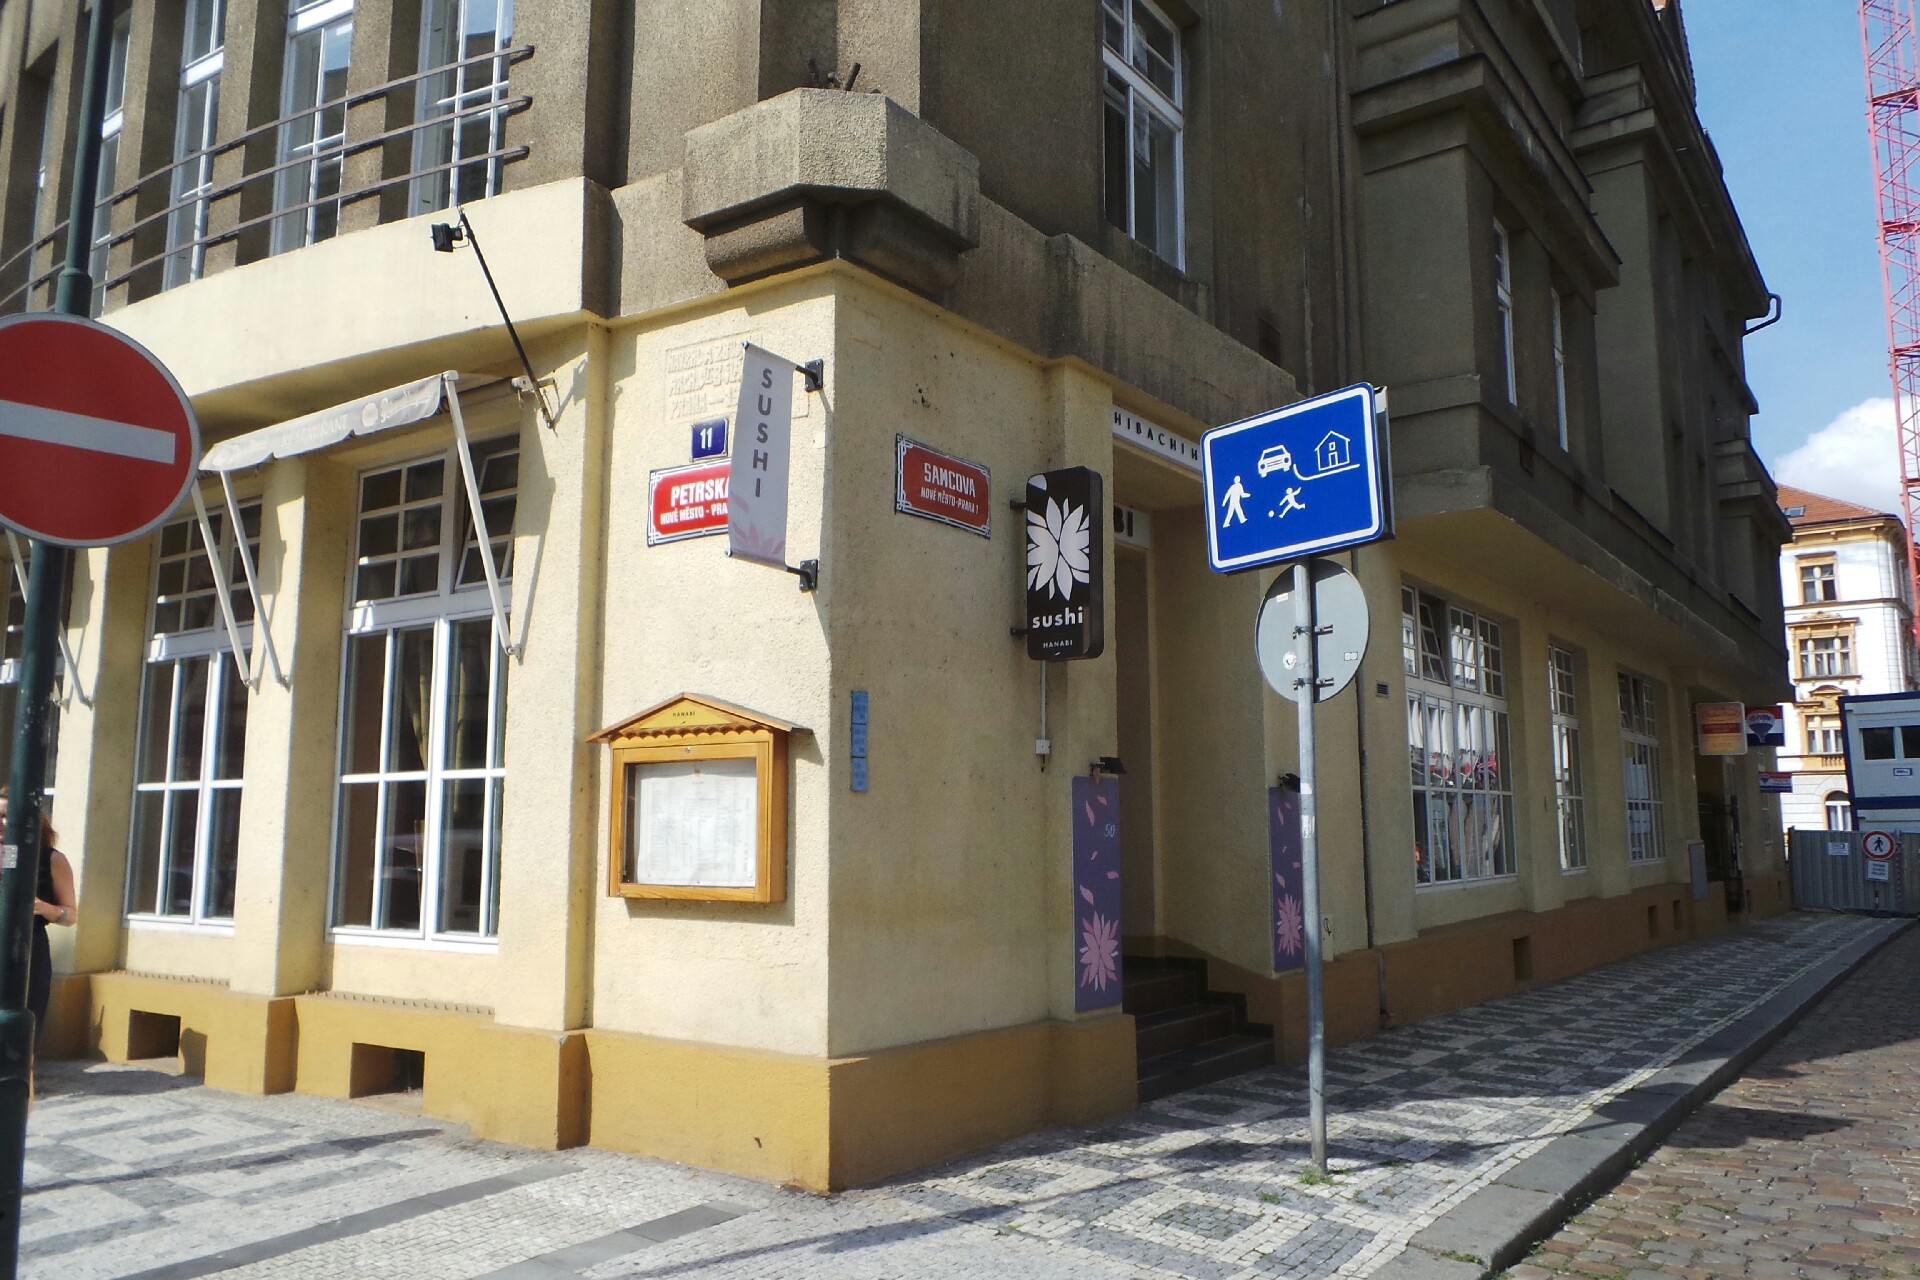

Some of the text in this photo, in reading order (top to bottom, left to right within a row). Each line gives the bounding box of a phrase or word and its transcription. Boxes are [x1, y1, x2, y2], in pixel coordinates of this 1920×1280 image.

[700, 427, 713, 450] 11
[752, 367, 773, 498] SUSHI
[1114, 411, 1185, 456] HIBACHI
[924, 462, 976, 498] SAMCOVA
[921, 486, 937, 501] NOVÉ
[660, 507, 679, 525] NOVÉ
[679, 505, 704, 523] MĚSTO
[1032, 606, 1083, 629] sushi
[1043, 639, 1073, 649] HANABI
